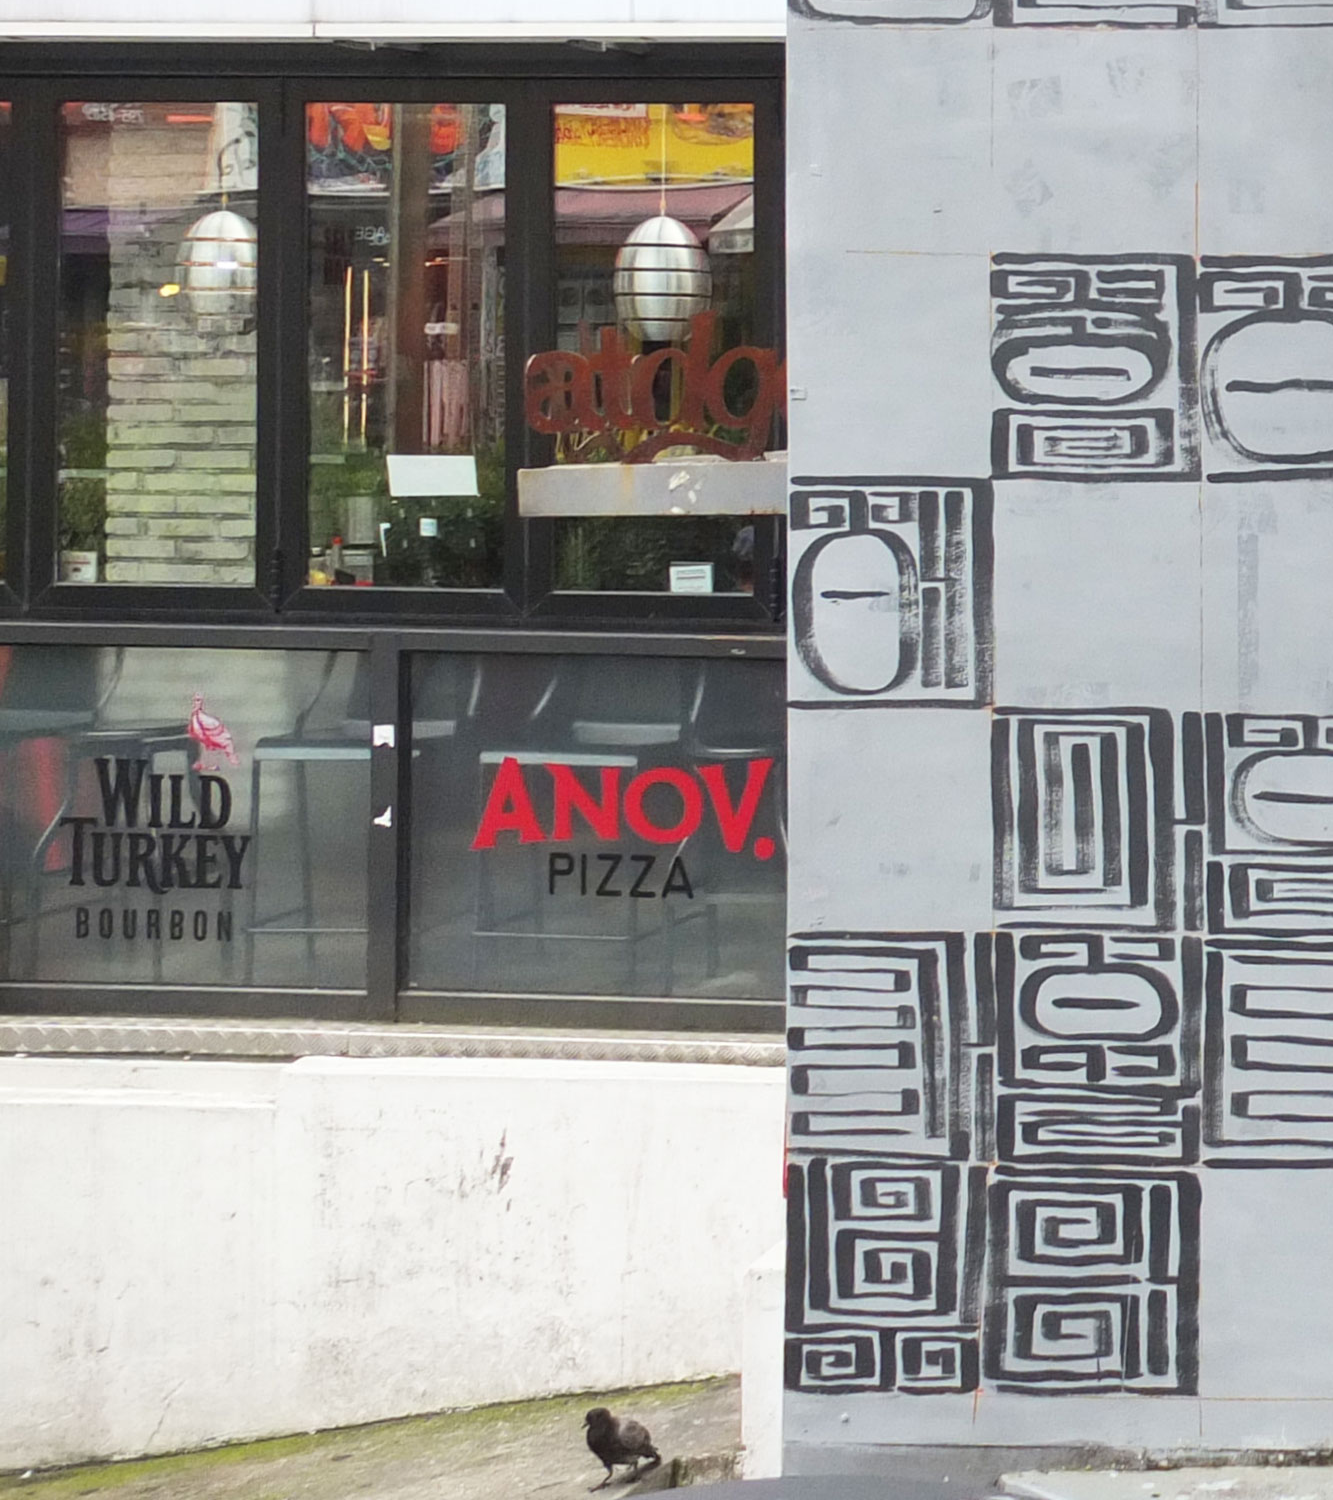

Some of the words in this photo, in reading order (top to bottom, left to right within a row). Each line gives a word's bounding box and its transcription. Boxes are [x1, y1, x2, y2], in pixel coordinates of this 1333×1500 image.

[94, 758, 233, 829] WILD
[470, 756, 777, 861] ANOV.
[59, 817, 251, 895] TURKEY
[549, 852, 694, 899] PIZZA
[75, 907, 233, 942] BOURBON
